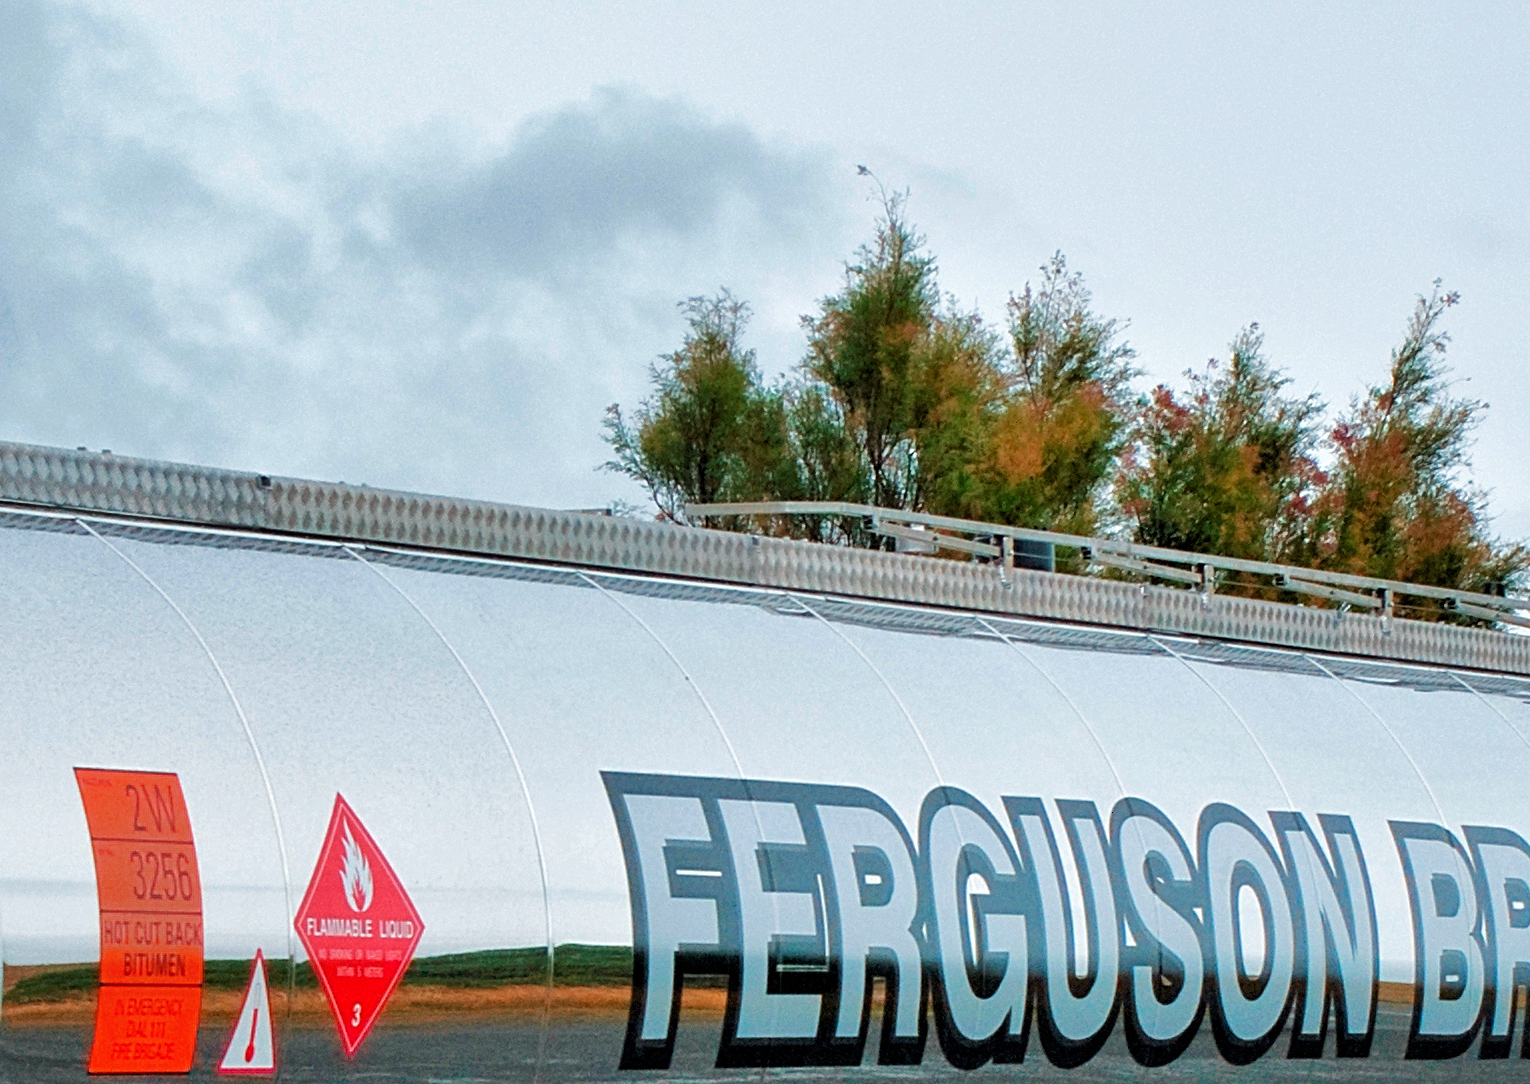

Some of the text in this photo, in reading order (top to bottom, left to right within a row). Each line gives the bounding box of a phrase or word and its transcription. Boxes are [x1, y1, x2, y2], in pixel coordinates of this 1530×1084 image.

[126, 784, 176, 833] 2W
[130, 851, 192, 901] 3256
[104, 920, 202, 946] HOT CUT BACK
[307, 918, 414, 938] FLAMMABLE LIQUID
[600, 770, 1380, 1070] FERGUSON
[123, 953, 186, 976] BITUMEN
[351, 1003, 361, 1027] 3
